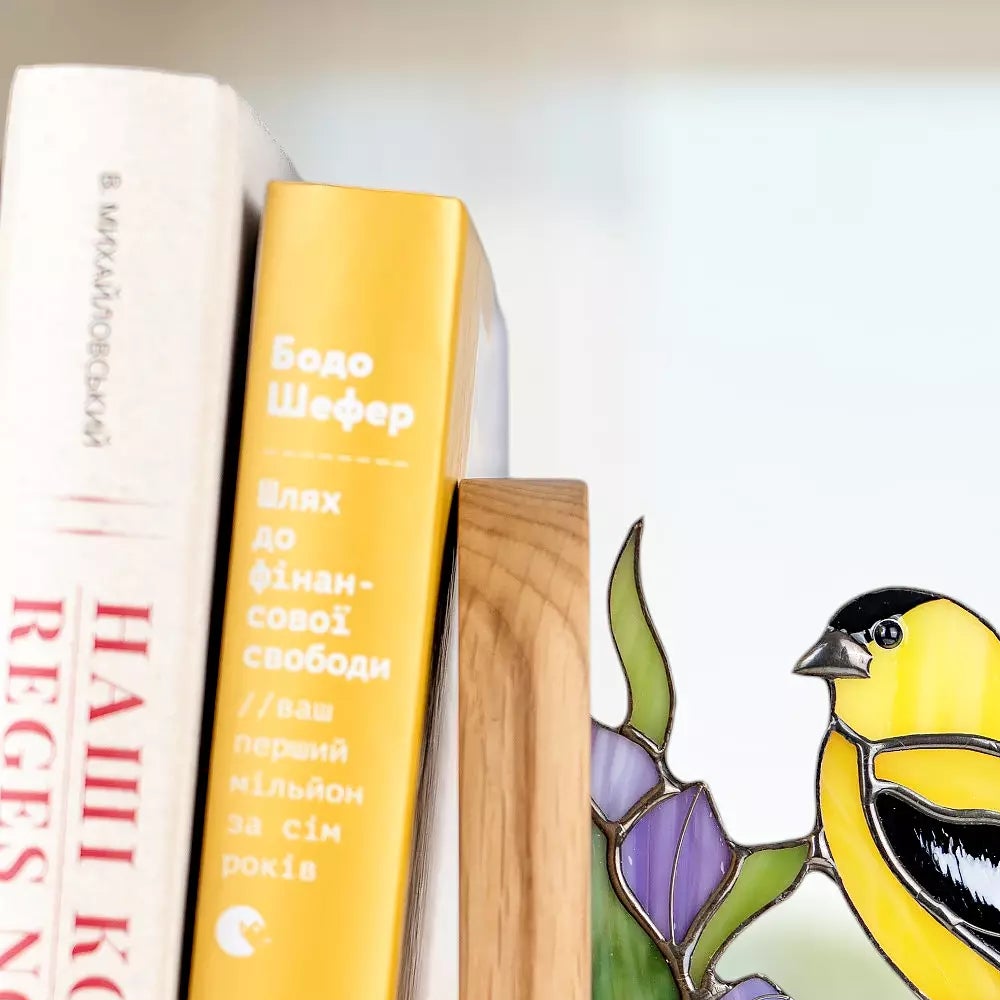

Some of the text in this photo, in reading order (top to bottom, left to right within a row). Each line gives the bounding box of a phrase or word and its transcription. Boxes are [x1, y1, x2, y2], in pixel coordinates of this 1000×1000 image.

[82, 202, 121, 448] МИХАЙЛОВСЬКИЙ
[271, 334, 374, 380] Бодо
[267, 380, 415, 437] Шефер
[257, 478, 342, 515] Шлях
[251, 524, 297, 553] до
[249, 557, 374, 597] фінан-
[246, 603, 352, 636] сової
[242, 642, 392, 683] свободи
[0, 596, 66, 884] REGES
[78, 598, 153, 867] НАШІ
[233, 733, 349, 763] перший
[229, 771, 364, 806] мільйон
[227, 813, 342, 844] за сім
[221, 854, 318, 883] років
